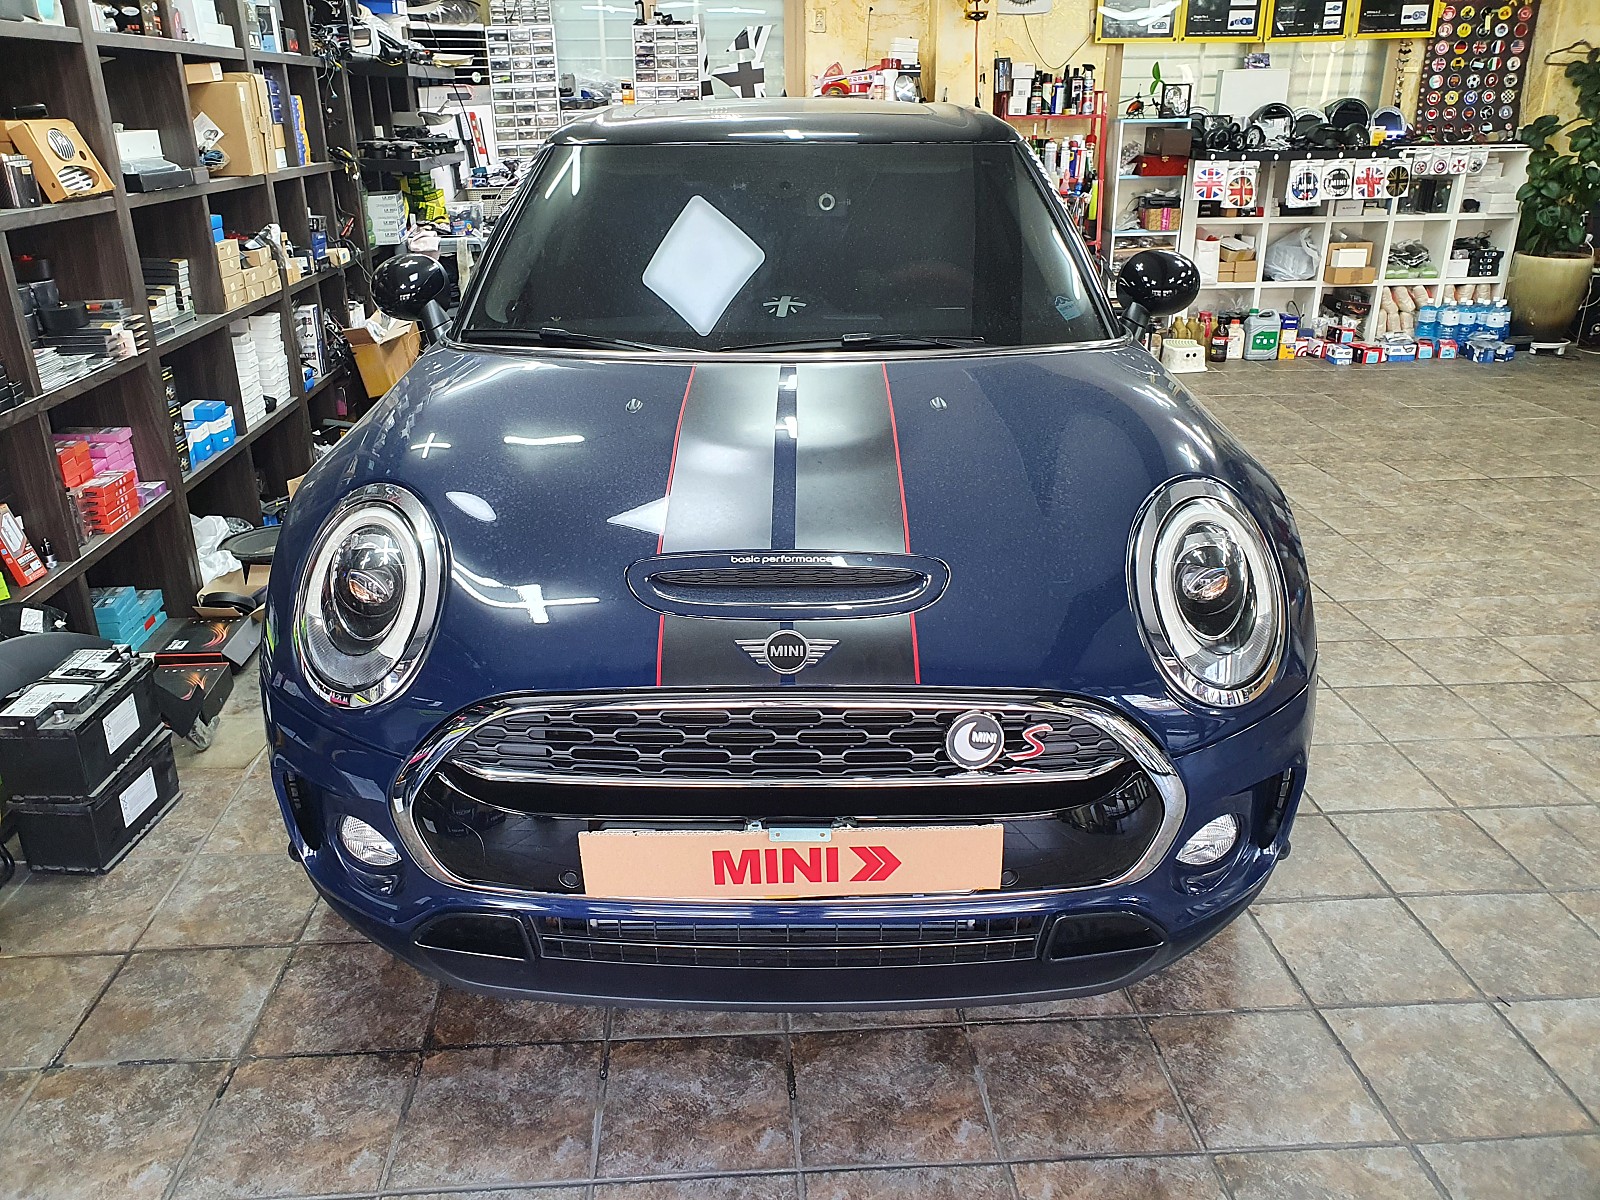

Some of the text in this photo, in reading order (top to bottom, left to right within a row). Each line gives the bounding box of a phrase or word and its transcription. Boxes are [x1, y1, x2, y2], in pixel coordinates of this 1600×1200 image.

[730, 554, 833, 564] basic performance
[769, 645, 804, 657] MINI
[971, 723, 1054, 762] MINI S
[711, 847, 839, 885] MINI
